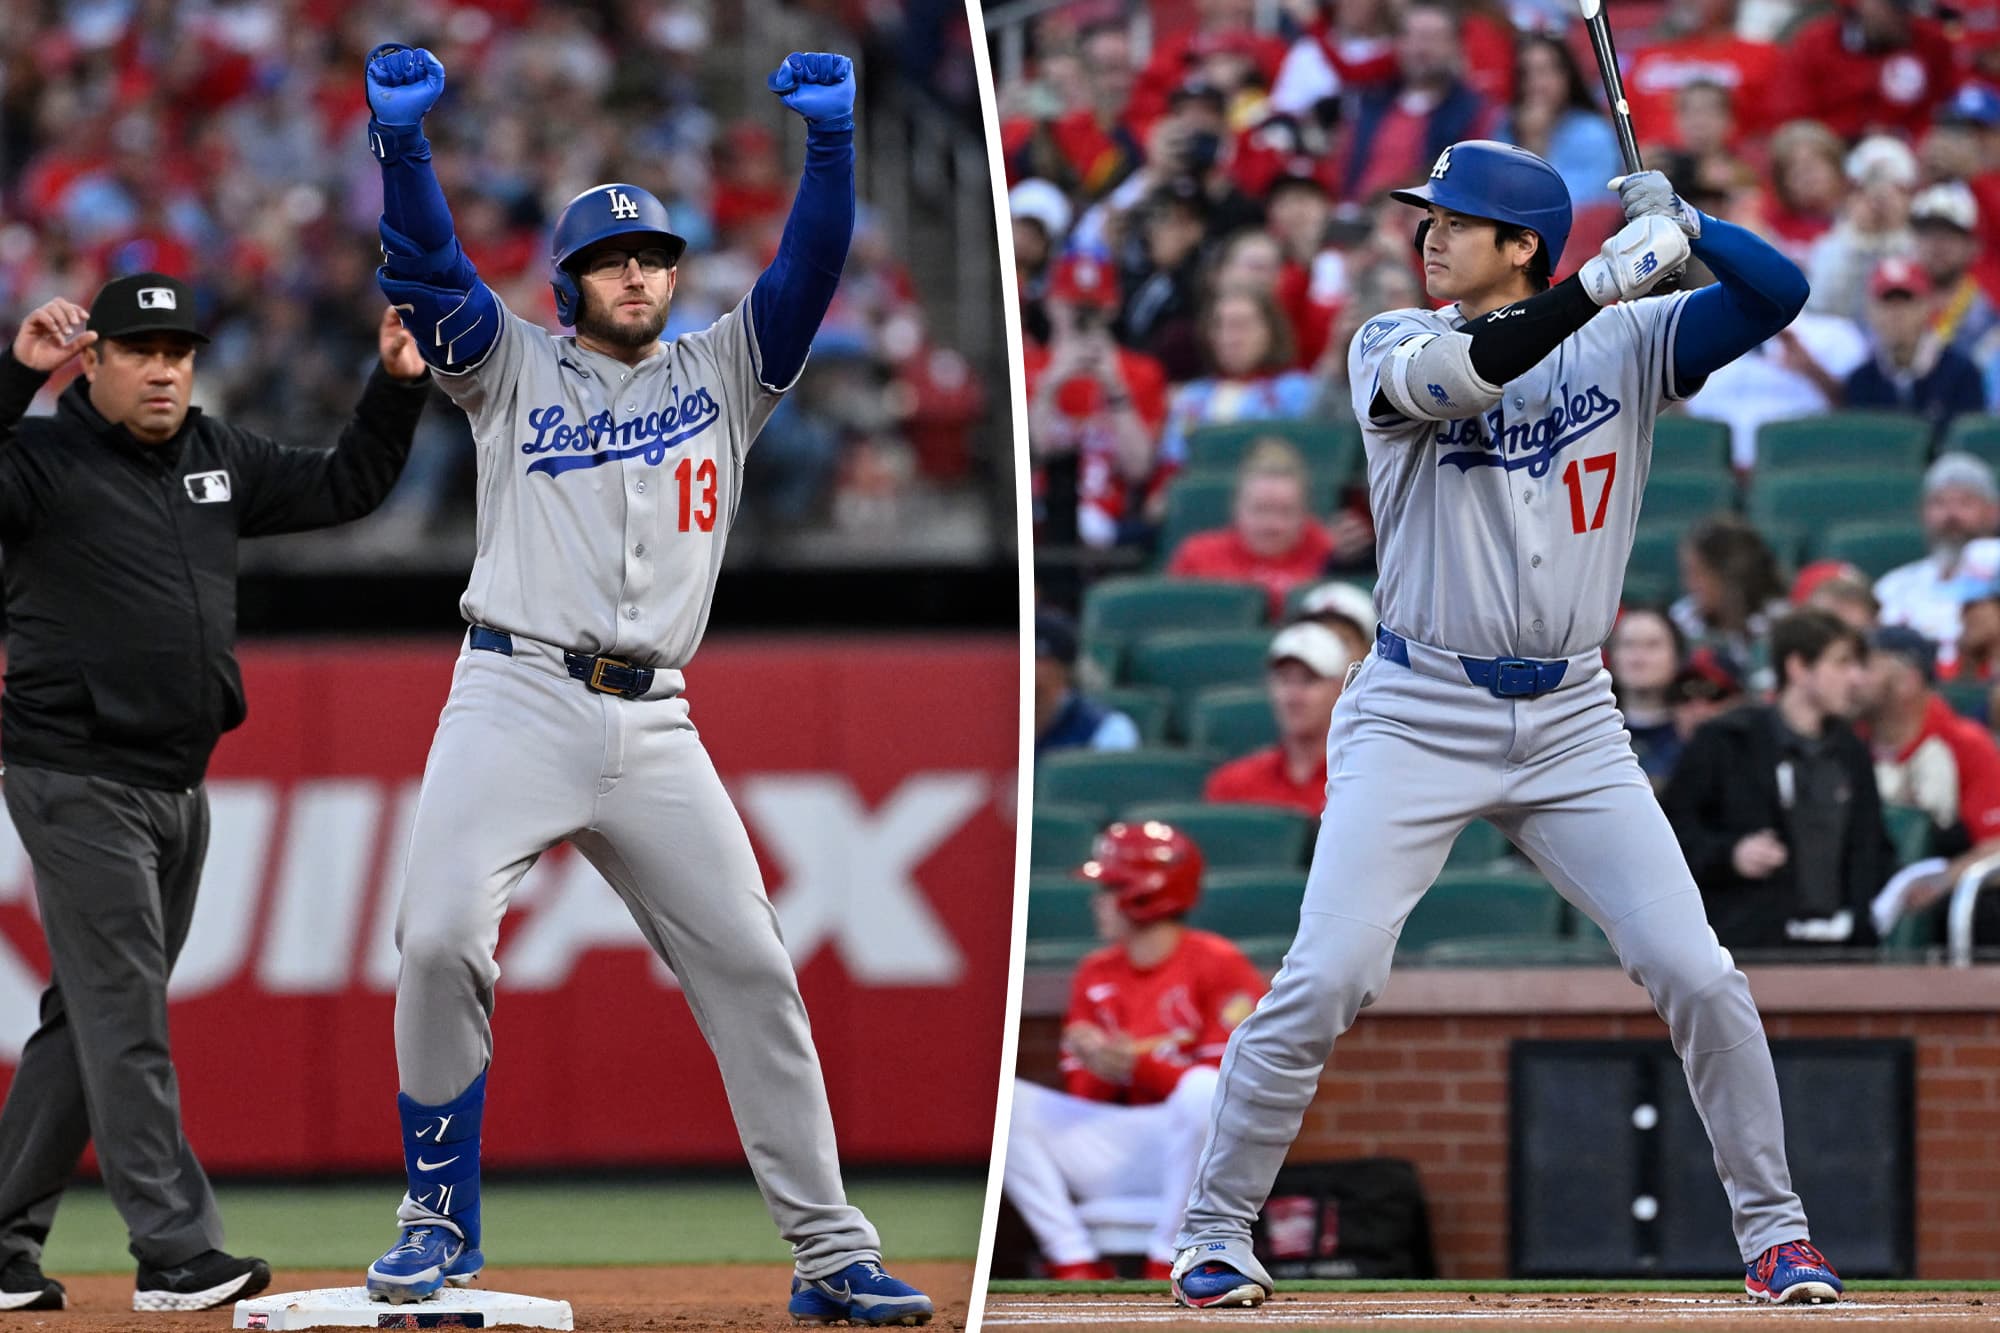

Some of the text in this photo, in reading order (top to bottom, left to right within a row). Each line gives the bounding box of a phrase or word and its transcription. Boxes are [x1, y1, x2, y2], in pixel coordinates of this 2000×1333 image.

[1431, 145, 1454, 179] LA
[606, 189, 639, 219] LA
[521, 385, 719, 466] Los Angeles
[1487, 383, 1621, 478] Angeles
[674, 458, 718, 533] 13
[1562, 452, 1617, 535] 17
